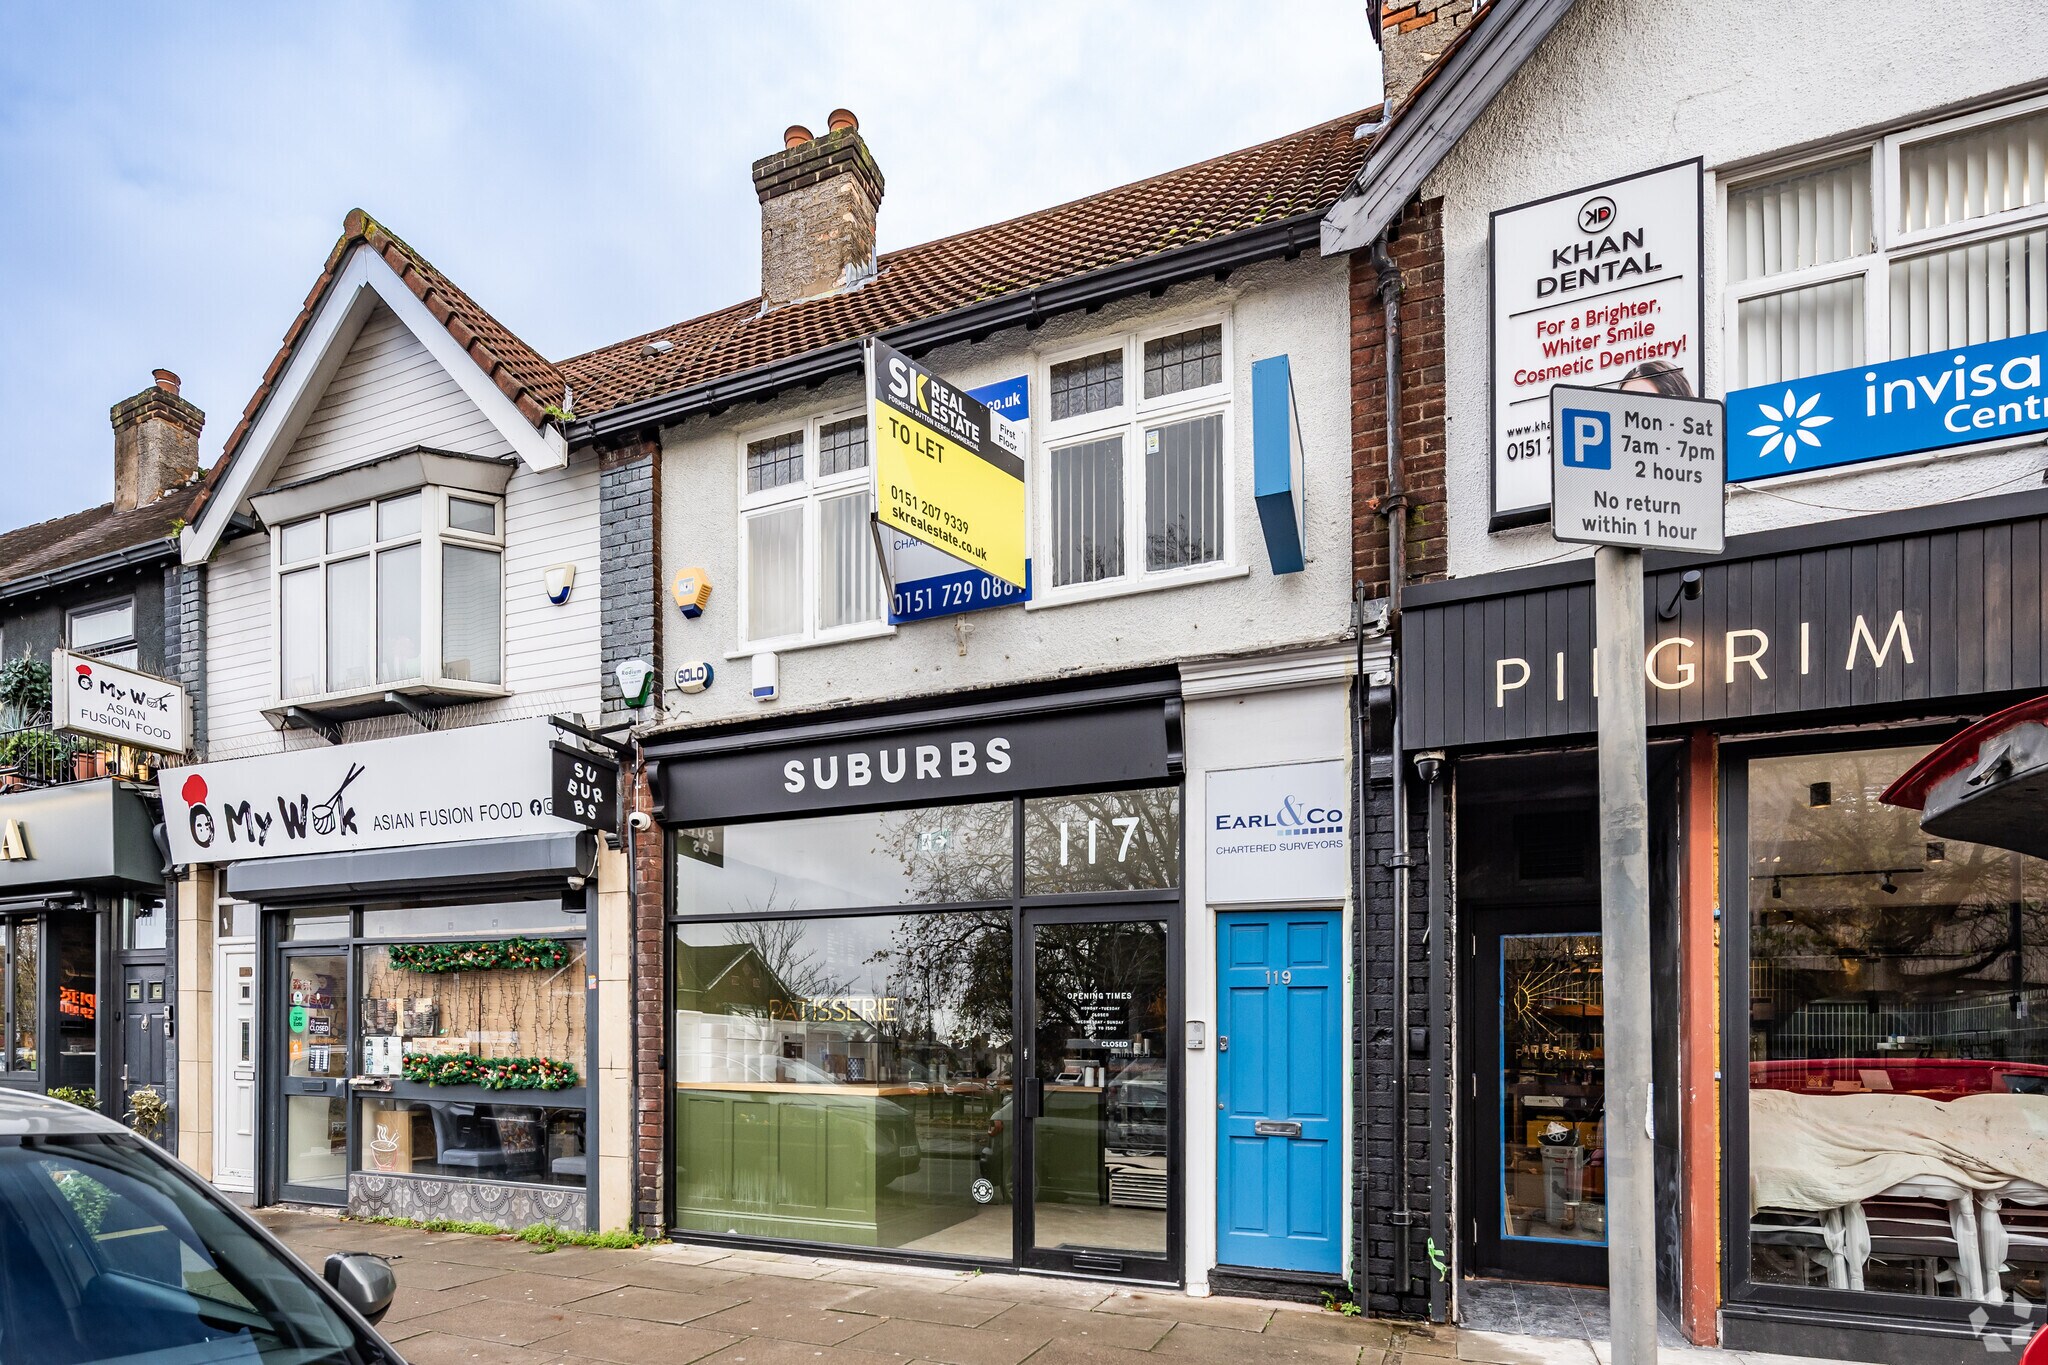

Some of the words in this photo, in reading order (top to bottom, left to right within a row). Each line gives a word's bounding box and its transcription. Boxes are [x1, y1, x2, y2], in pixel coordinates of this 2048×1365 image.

[1552, 227, 1644, 270] KHAN
[1536, 252, 1662, 299] DENTAL
[1537, 320, 1566, 338] For
[1571, 316, 1580, 330] a
[1586, 299, 1662, 326] Brighter,
[1542, 335, 1601, 358] Whiter
[1606, 320, 1656, 345] Smile
[1513, 355, 1594, 386] Cosmetic
[1599, 334, 1688, 370] Dentistry!
[888, 357, 930, 415] SK
[930, 380, 967, 417] REAL
[1864, 354, 2041, 417] invisa
[888, 394, 915, 414] FORMERLY
[914, 409, 934, 426] SUTTON
[950, 429, 980, 452] COMMERCIAL
[931, 400, 980, 443] ESTATE
[1000, 423, 1016, 440] First
[1624, 410, 1663, 431] Mon
[1682, 416, 1713, 437] Sat
[889, 417, 910, 445] TO
[915, 431, 945, 464] LET
[998, 434, 1018, 452] Floor
[1507, 438, 1541, 461] 0151
[1574, 416, 1604, 463] P
[1621, 435, 1659, 455] 7am
[1677, 440, 1715, 462] 7pm
[1635, 461, 1646, 478] 2
[1653, 462, 1703, 484] hours
[890, 485, 918, 510] 0151
[921, 501, 941, 521] 207
[943, 511, 969, 535] 9339
[1594, 490, 1619, 509] No
[1626, 496, 1681, 515] return
[892, 506, 988, 561] skrealestate.co.uk
[1581, 516, 1637, 536] within
[1644, 520, 1650, 536] 1
[1658, 521, 1698, 540] hour
[894, 587, 932, 616] 0151
[941, 580, 973, 608] 729
[980, 576, 1023, 600] 088
[1497, 610, 1914, 708] PIGRIM
[100, 680, 126, 700] My
[677, 666, 704, 684] SOLO
[81, 708, 130, 730] FUSION
[136, 723, 171, 740] FOOD
[106, 703, 146, 721] ASIAN
[573, 762, 598, 783] SU
[783, 737, 1012, 794] SUBURBS
[566, 778, 604, 804] BUR
[224, 800, 273, 847] My
[373, 812, 414, 832] ASIAN
[419, 806, 474, 827] FUSION
[479, 801, 523, 822] FOOD
[573, 799, 597, 820] BS
[1059, 815, 1140, 866] 117
[1215, 843, 1277, 855] CHARTERED
[1279, 839, 1343, 852] SURVEYORS
[1265, 970, 1292, 985] 119
[769, 997, 898, 1022] PATISSERIE
[1067, 992, 1104, 1000] OPENING
[1106, 992, 1132, 1000] TIMES
[1101, 1040, 1128, 1048] CLOSED
[1515, 1048, 1591, 1060] PILGRIM
